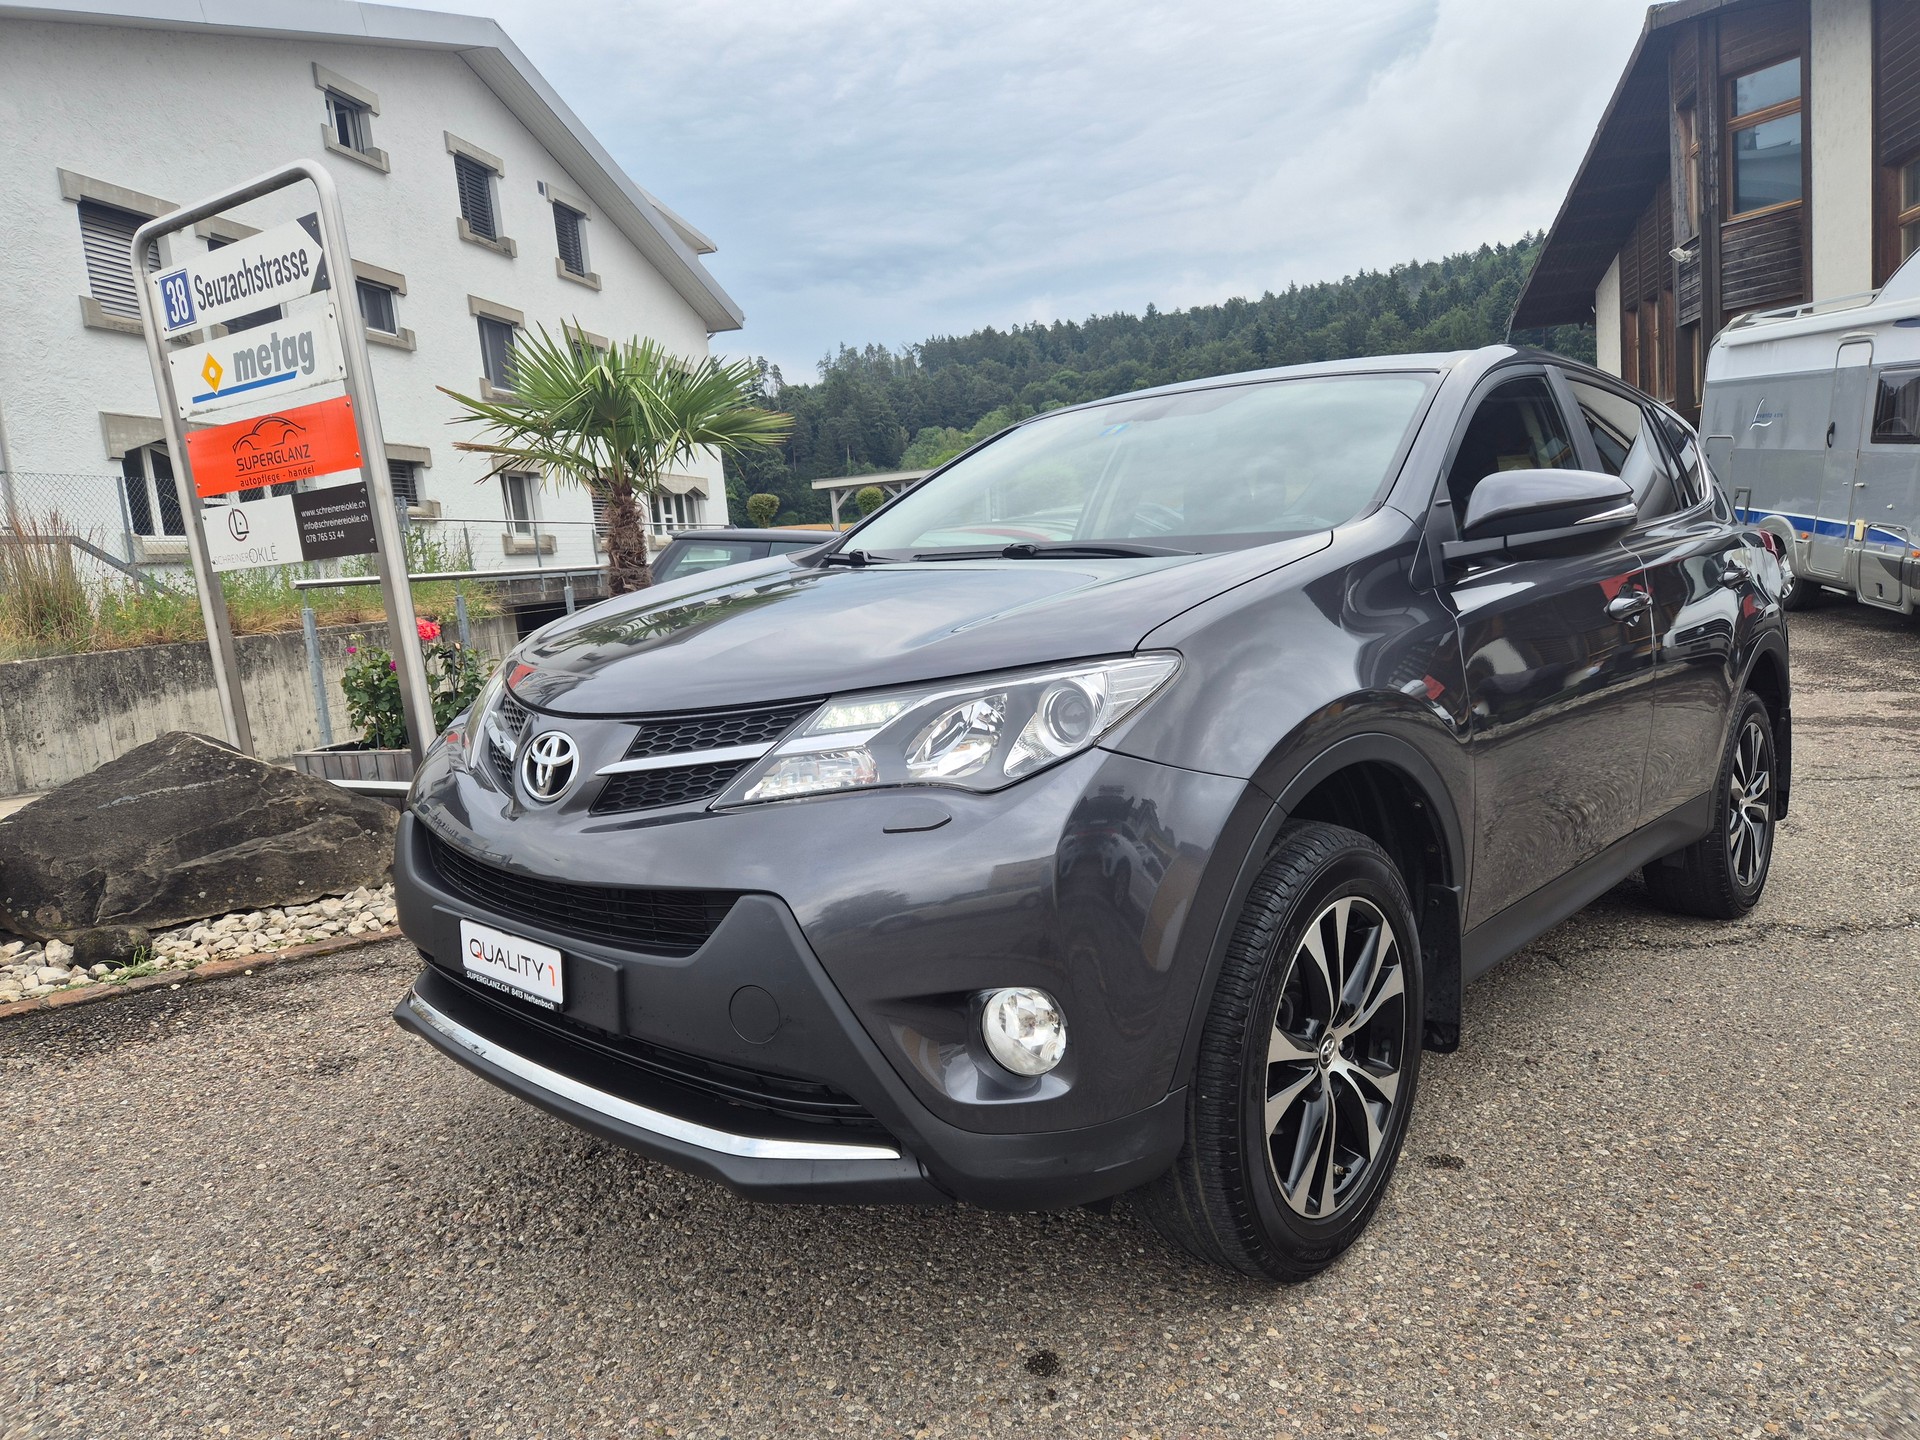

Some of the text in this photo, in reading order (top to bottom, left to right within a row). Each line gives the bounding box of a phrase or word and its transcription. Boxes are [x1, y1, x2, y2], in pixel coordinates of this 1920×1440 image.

[166, 248, 310, 323] 38 Seuzachstrasse
[232, 330, 315, 383] metag
[236, 444, 311, 472] SUPERGLANZ
[240, 473, 280, 487] autopflege
[287, 464, 315, 477] handel
[305, 530, 345, 543] 078 765 53 44
[469, 938, 556, 987] QUALITY 1
[466, 970, 510, 994] SUPERGLANZ.CH
[523, 992, 555, 1010] Neftenbach
